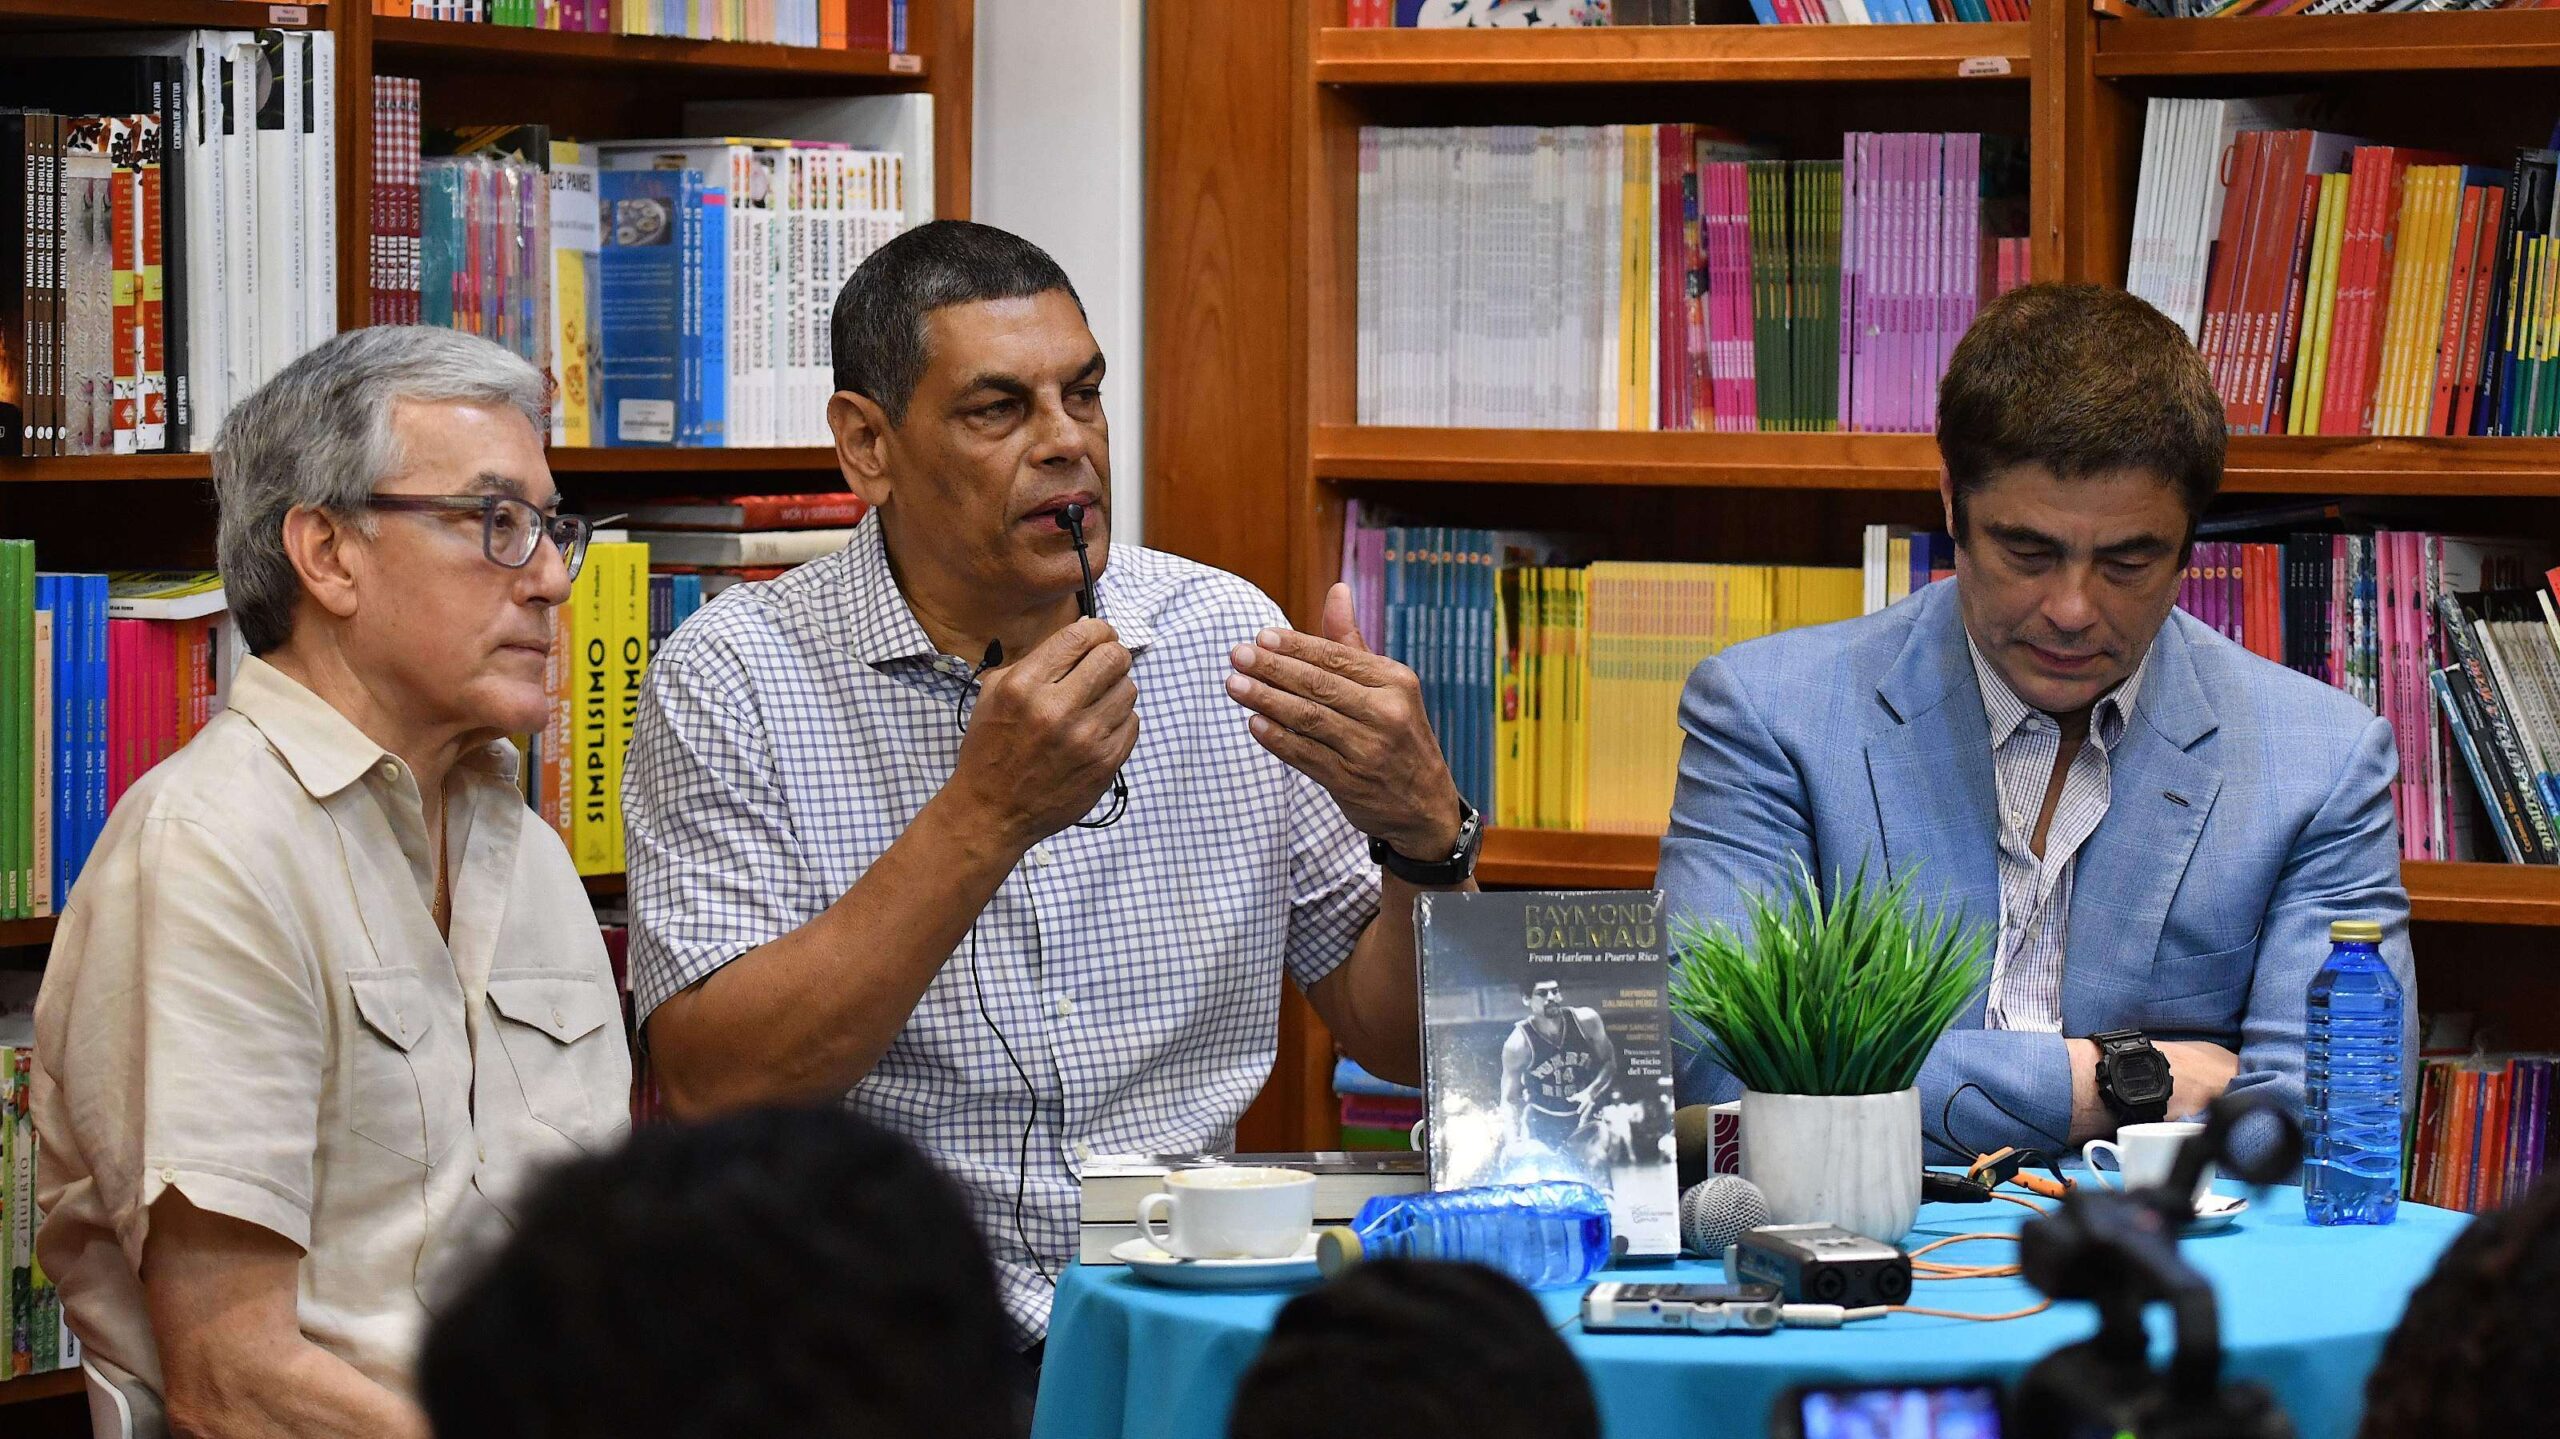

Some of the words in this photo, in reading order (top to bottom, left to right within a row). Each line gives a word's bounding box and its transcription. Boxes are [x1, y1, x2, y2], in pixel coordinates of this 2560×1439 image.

[153, 81, 161, 109] AUTOR
[172, 82, 181, 109] AUTOR
[173, 120, 181, 149] COCINA
[27, 154, 35, 191] CRIOLLO
[38, 155, 46, 194] CRIOLLO
[46, 156, 54, 193] CRIOLLO
[60, 156, 68, 194] CRIOLLO
[26, 194, 34, 229] ASADOR
[38, 194, 46, 230] ASADOR
[46, 195, 54, 230] ASADOR
[26, 231, 34, 247] DEL
[752, 222, 762, 276] COCINA
[786, 217, 796, 284] VERDURAS
[795, 216, 804, 272] CARNES
[810, 219, 819, 281] PESCADO
[819, 220, 829, 281] PESCADO
[836, 219, 845, 281] PESCADO
[26, 251, 34, 287] MANUAL
[377, 236, 386, 290] BIFES
[388, 236, 397, 290] BIFES
[399, 236, 408, 290] BIFES
[411, 237, 420, 291] BIFES
[752, 281, 762, 299] DE
[786, 289, 796, 305] DE
[796, 281, 805, 297] DE
[811, 286, 820, 302] DE
[820, 286, 829, 302] DE
[2288, 278, 2299, 309] ORIGAMI
[2450, 278, 2464, 334] LITERARY
[2473, 278, 2486, 334] LITERARY
[752, 304, 762, 368] ESCUELA
[787, 310, 796, 366] ESCUELA
[797, 303, 806, 368] ESCUELA
[812, 307, 820, 366] ESCUELA
[821, 307, 830, 366] ESCUELA
[2284, 311, 2295, 338] PAPER
[2280, 338, 2290, 364] BOXES
[2442, 340, 2456, 379] YARNS
[2465, 340, 2479, 379] YARNS
[560, 700, 571, 744] PAN
[560, 756, 571, 829] SALUD
[1525, 904, 1655, 925] RAYMOND
[1526, 926, 1657, 949] DALMAU
[1528, 952, 1553, 963] From
[1556, 952, 1592, 963] Harlem
[1604, 952, 1636, 963] Puerto
[1638, 951, 1659, 962] Rico
[1554, 1067, 1574, 1084] 14
[1627, 1067, 1641, 1076] del
[1643, 1067, 1661, 1076] Toro
[1630, 1057, 1661, 1066] Benicio
[19, 1157, 28, 1231] HUERTO
